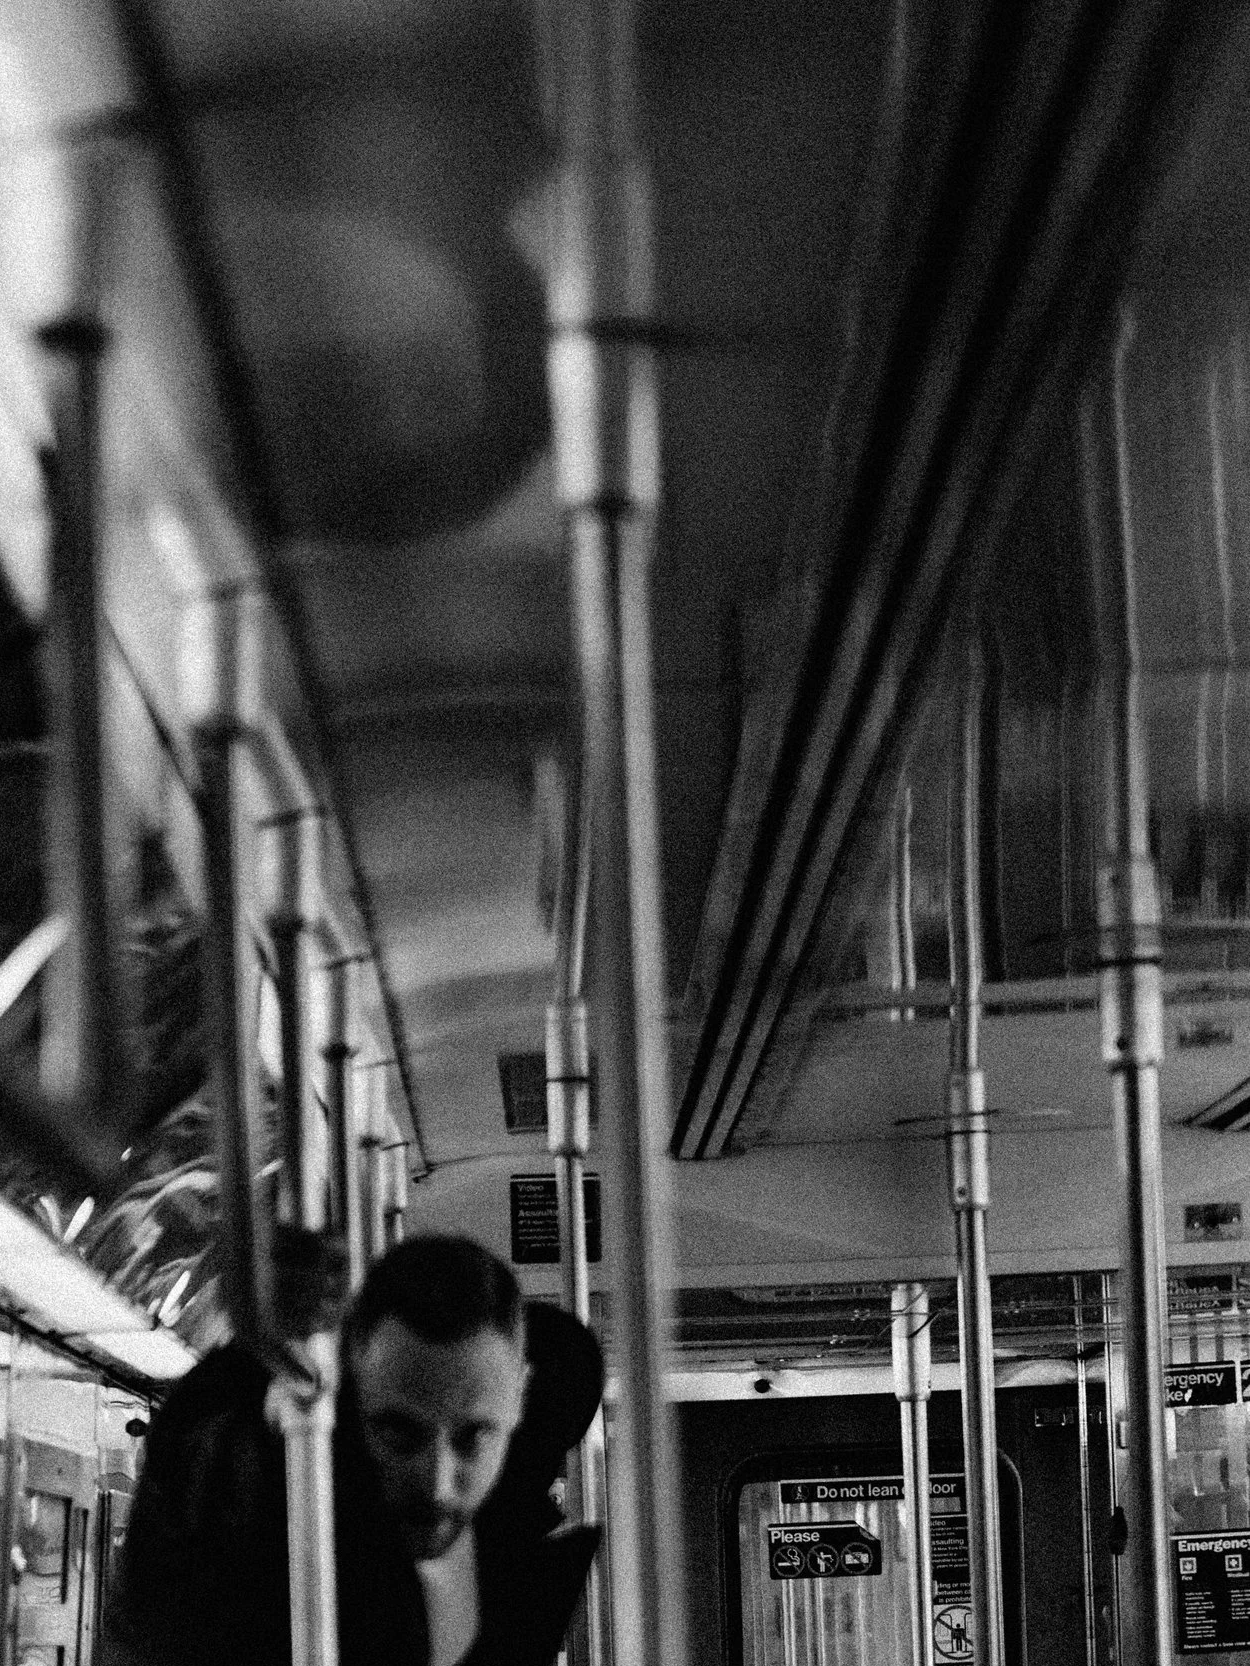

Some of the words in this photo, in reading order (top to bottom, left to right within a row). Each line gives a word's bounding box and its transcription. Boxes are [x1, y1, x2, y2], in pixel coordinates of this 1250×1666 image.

[1164, 1372, 1224, 1389] ergency
[816, 1485, 838, 1498] Do
[840, 1484, 864, 1498] not
[867, 1483, 899, 1497] lean
[771, 1530, 820, 1544] Please
